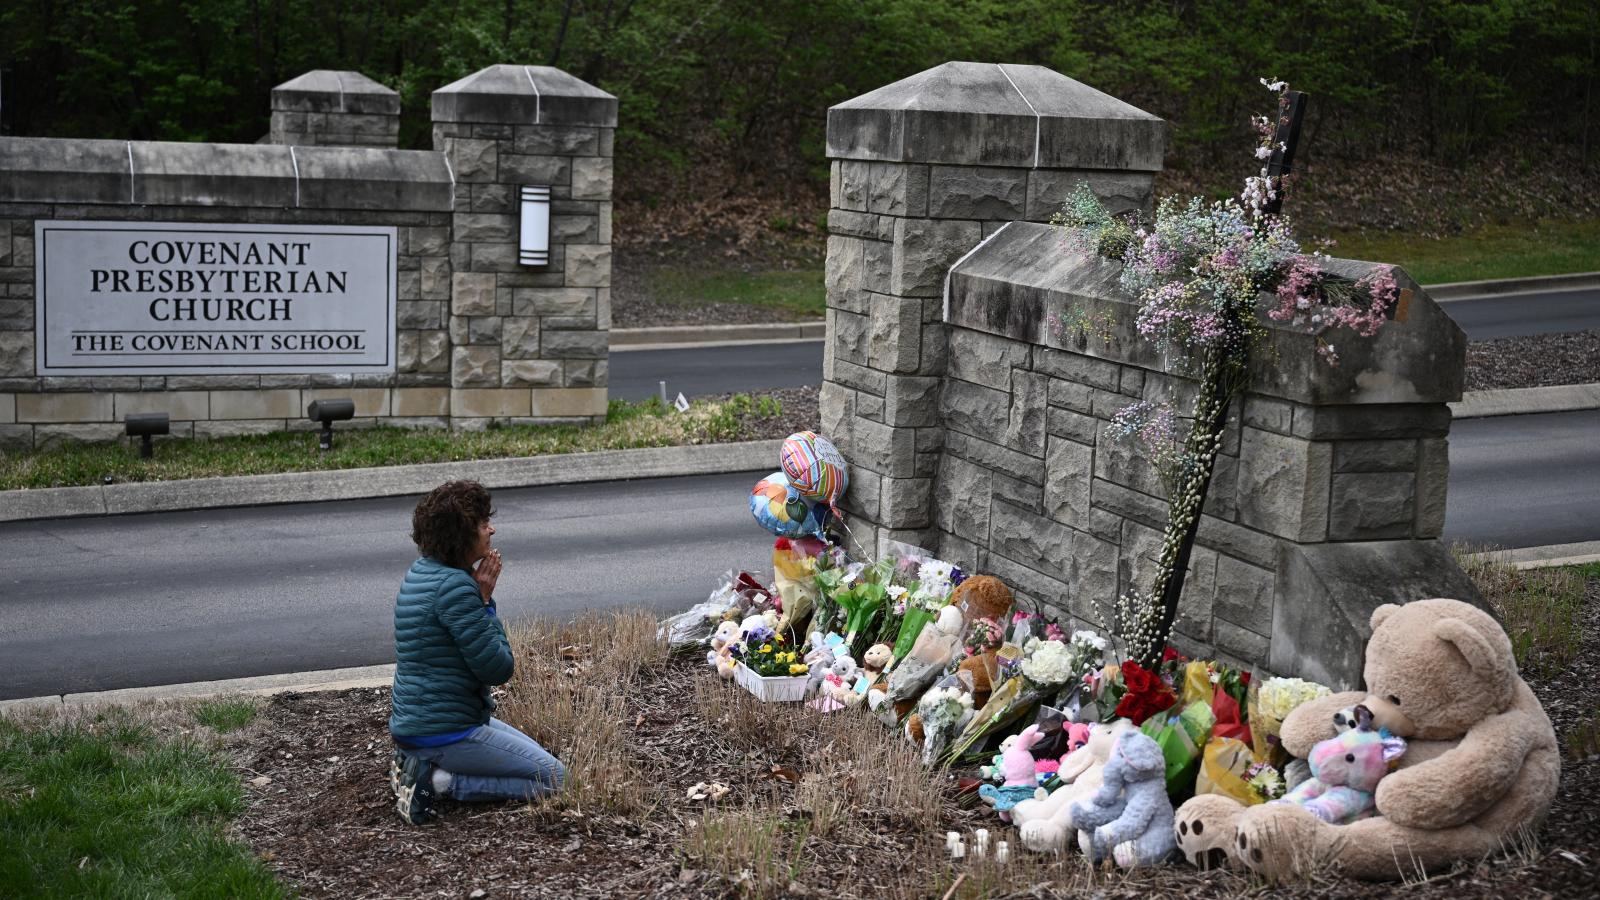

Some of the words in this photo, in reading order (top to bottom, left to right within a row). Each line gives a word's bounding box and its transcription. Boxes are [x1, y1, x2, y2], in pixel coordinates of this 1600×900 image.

[128, 240, 311, 265] COVENANT
[89, 269, 348, 294] PRESBYTERIAN
[149, 297, 293, 322] CHURCH
[72, 334, 124, 352] THE
[131, 334, 265, 352] COVENANT
[271, 334, 366, 351] SCHOOL
